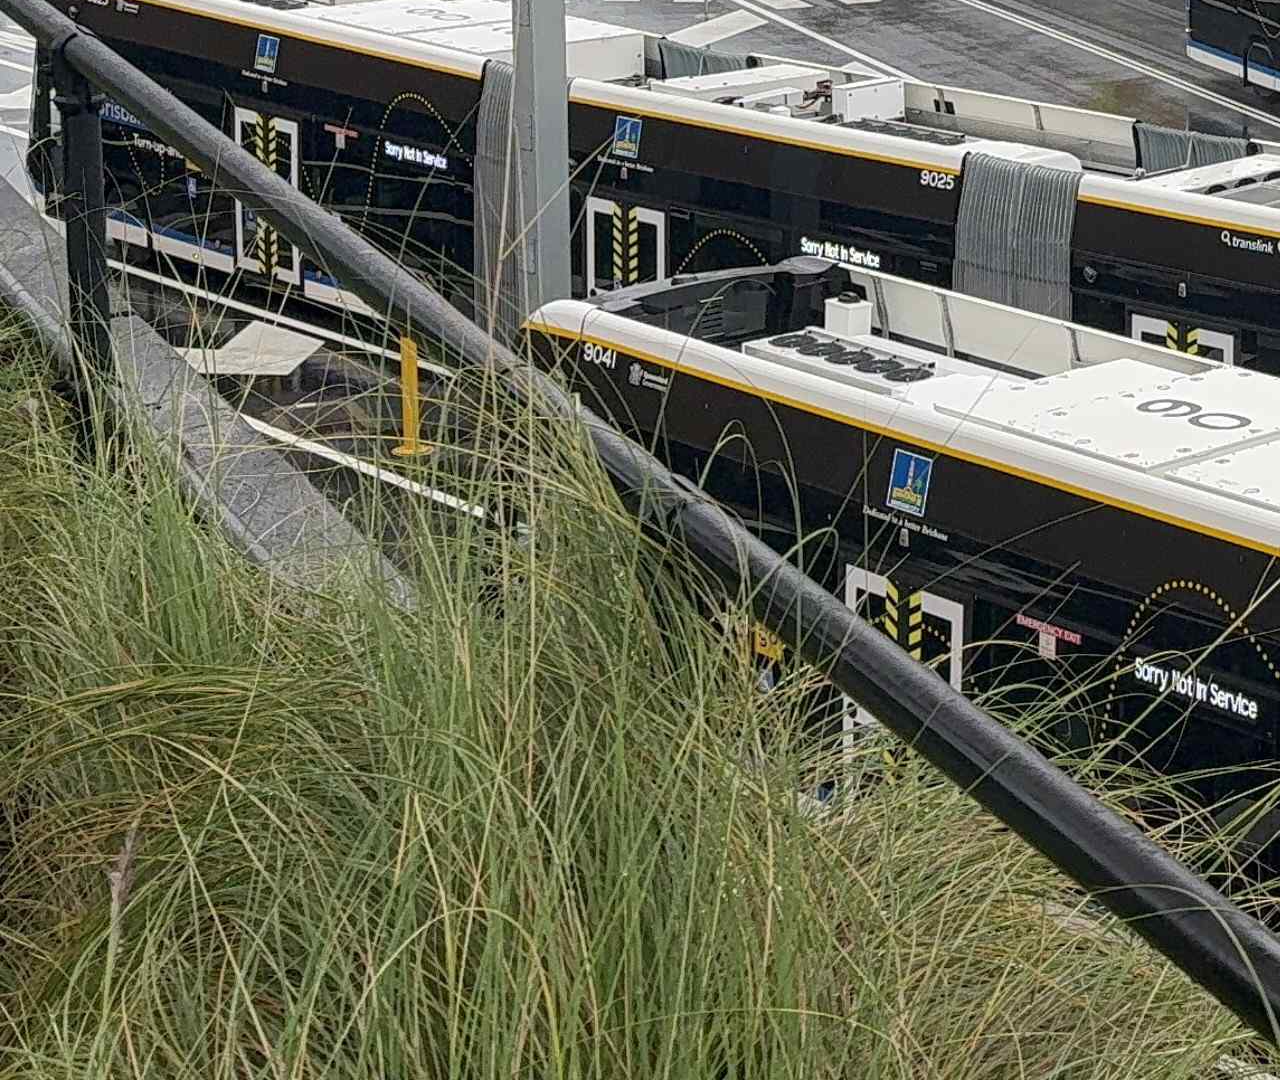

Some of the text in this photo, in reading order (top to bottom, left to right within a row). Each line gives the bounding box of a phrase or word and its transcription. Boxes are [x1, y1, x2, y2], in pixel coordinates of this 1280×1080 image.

[920, 170, 954, 190] 9025
[801, 236, 824, 258] Sorry
[825, 241, 839, 260] Not
[850, 247, 880, 268] Service
[1232, 236, 1273, 255] translink
[583, 343, 617, 369] 9041
[1016, 613, 1082, 645] EMERGENCY EXIT
[1134, 657, 1169, 693] Sorry
[1171, 671, 1194, 698] Not
[1209, 684, 1258, 720] Service
